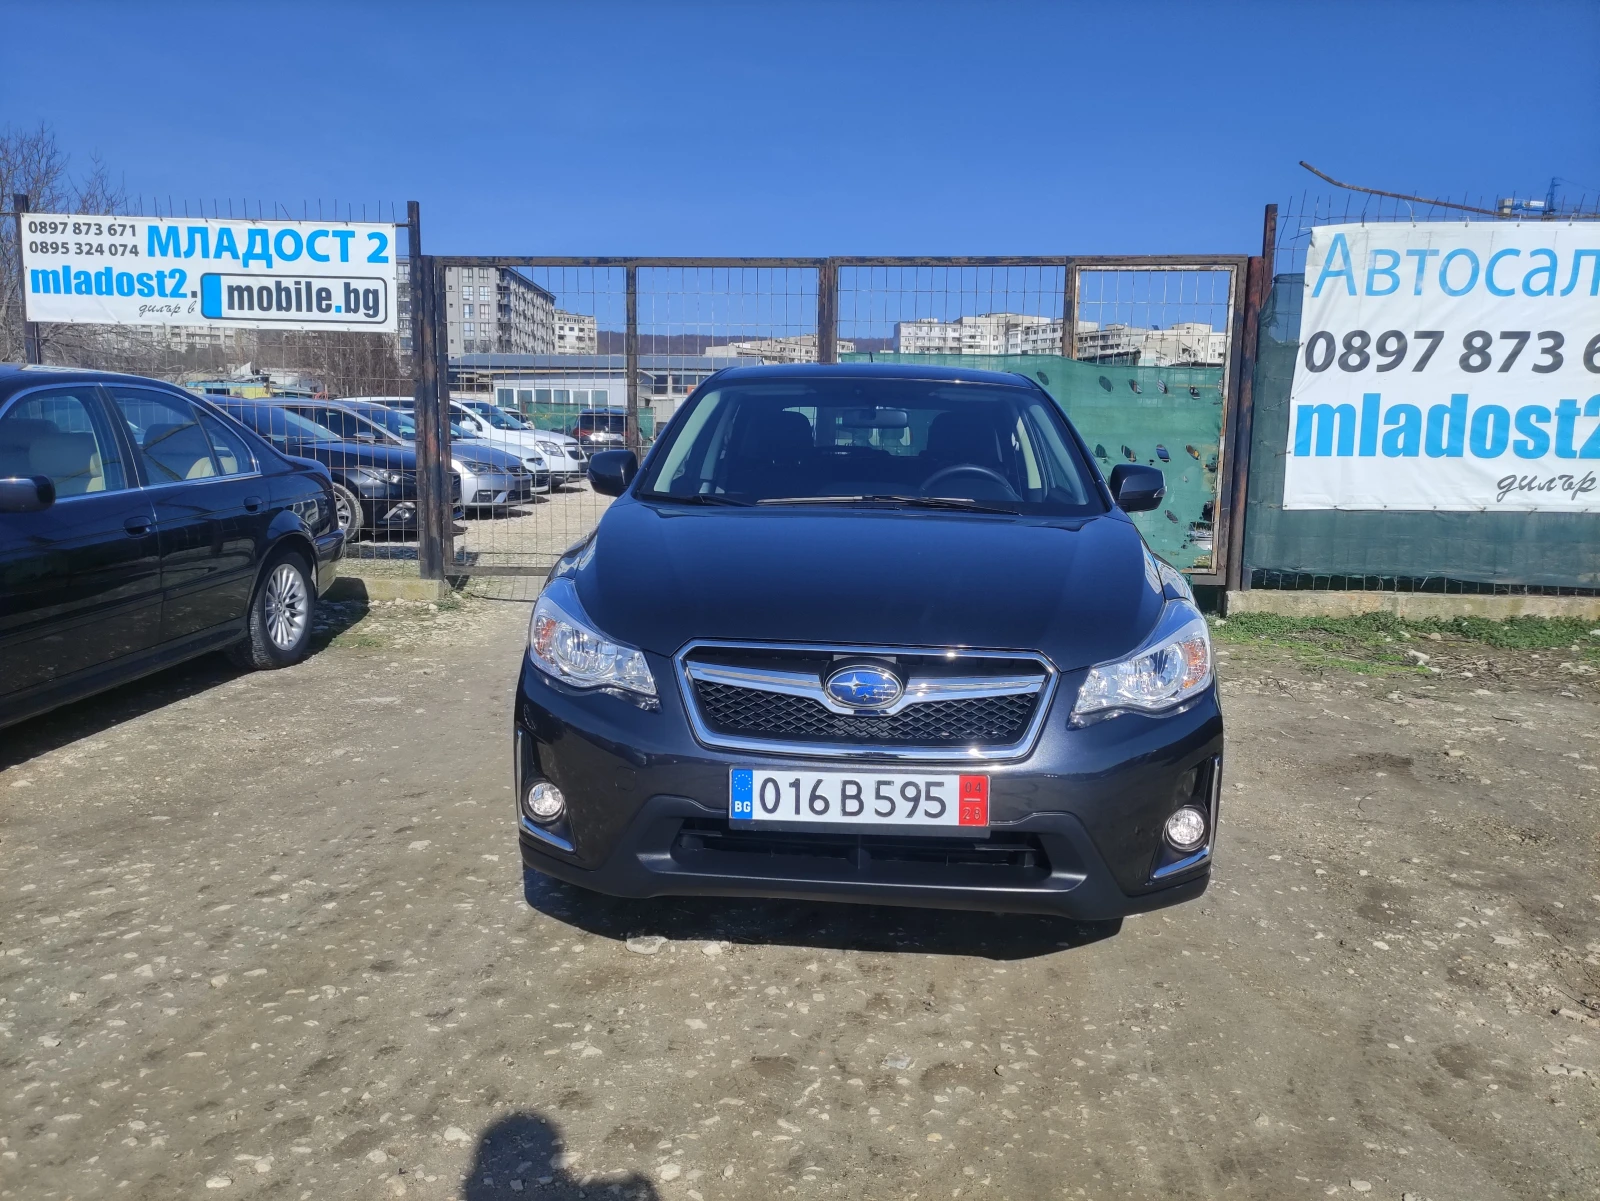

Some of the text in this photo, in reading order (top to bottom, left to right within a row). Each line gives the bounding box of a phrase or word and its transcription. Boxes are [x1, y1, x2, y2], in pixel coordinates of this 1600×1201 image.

[28, 221, 136, 237] 0897 873 671
[29, 241, 139, 257] 0895 324 074
[147, 225, 389, 269] МЛАДОСТ 2
[227, 280, 380, 318] mobile.bg
[139, 303, 181, 317] дилър
[1304, 330, 1445, 374] 0897
[1458, 330, 1565, 374] 873
[1496, 470, 1598, 503] дилър
[965, 781, 982, 793] 04
[734, 801, 751, 813] BG
